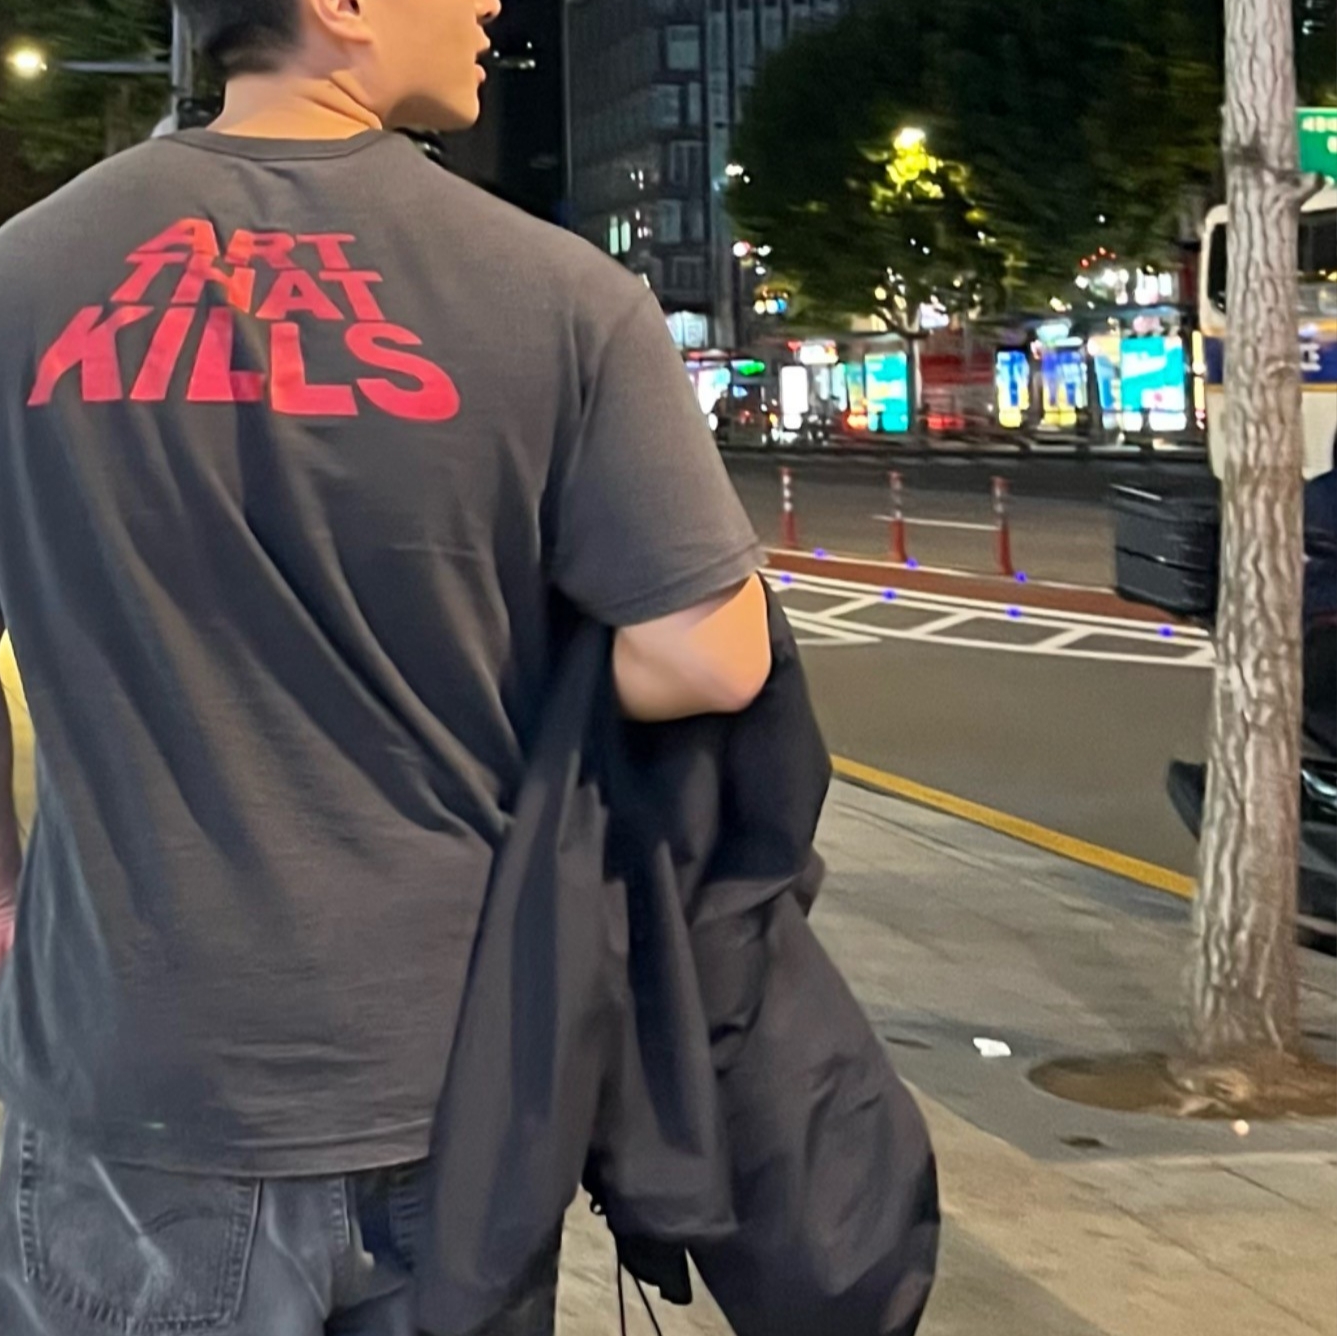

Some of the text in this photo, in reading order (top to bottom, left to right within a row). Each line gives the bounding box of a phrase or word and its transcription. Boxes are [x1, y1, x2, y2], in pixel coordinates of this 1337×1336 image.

[130, 217, 356, 270] ART
[110, 252, 387, 322] THAT
[27, 305, 461, 422] KILLS
